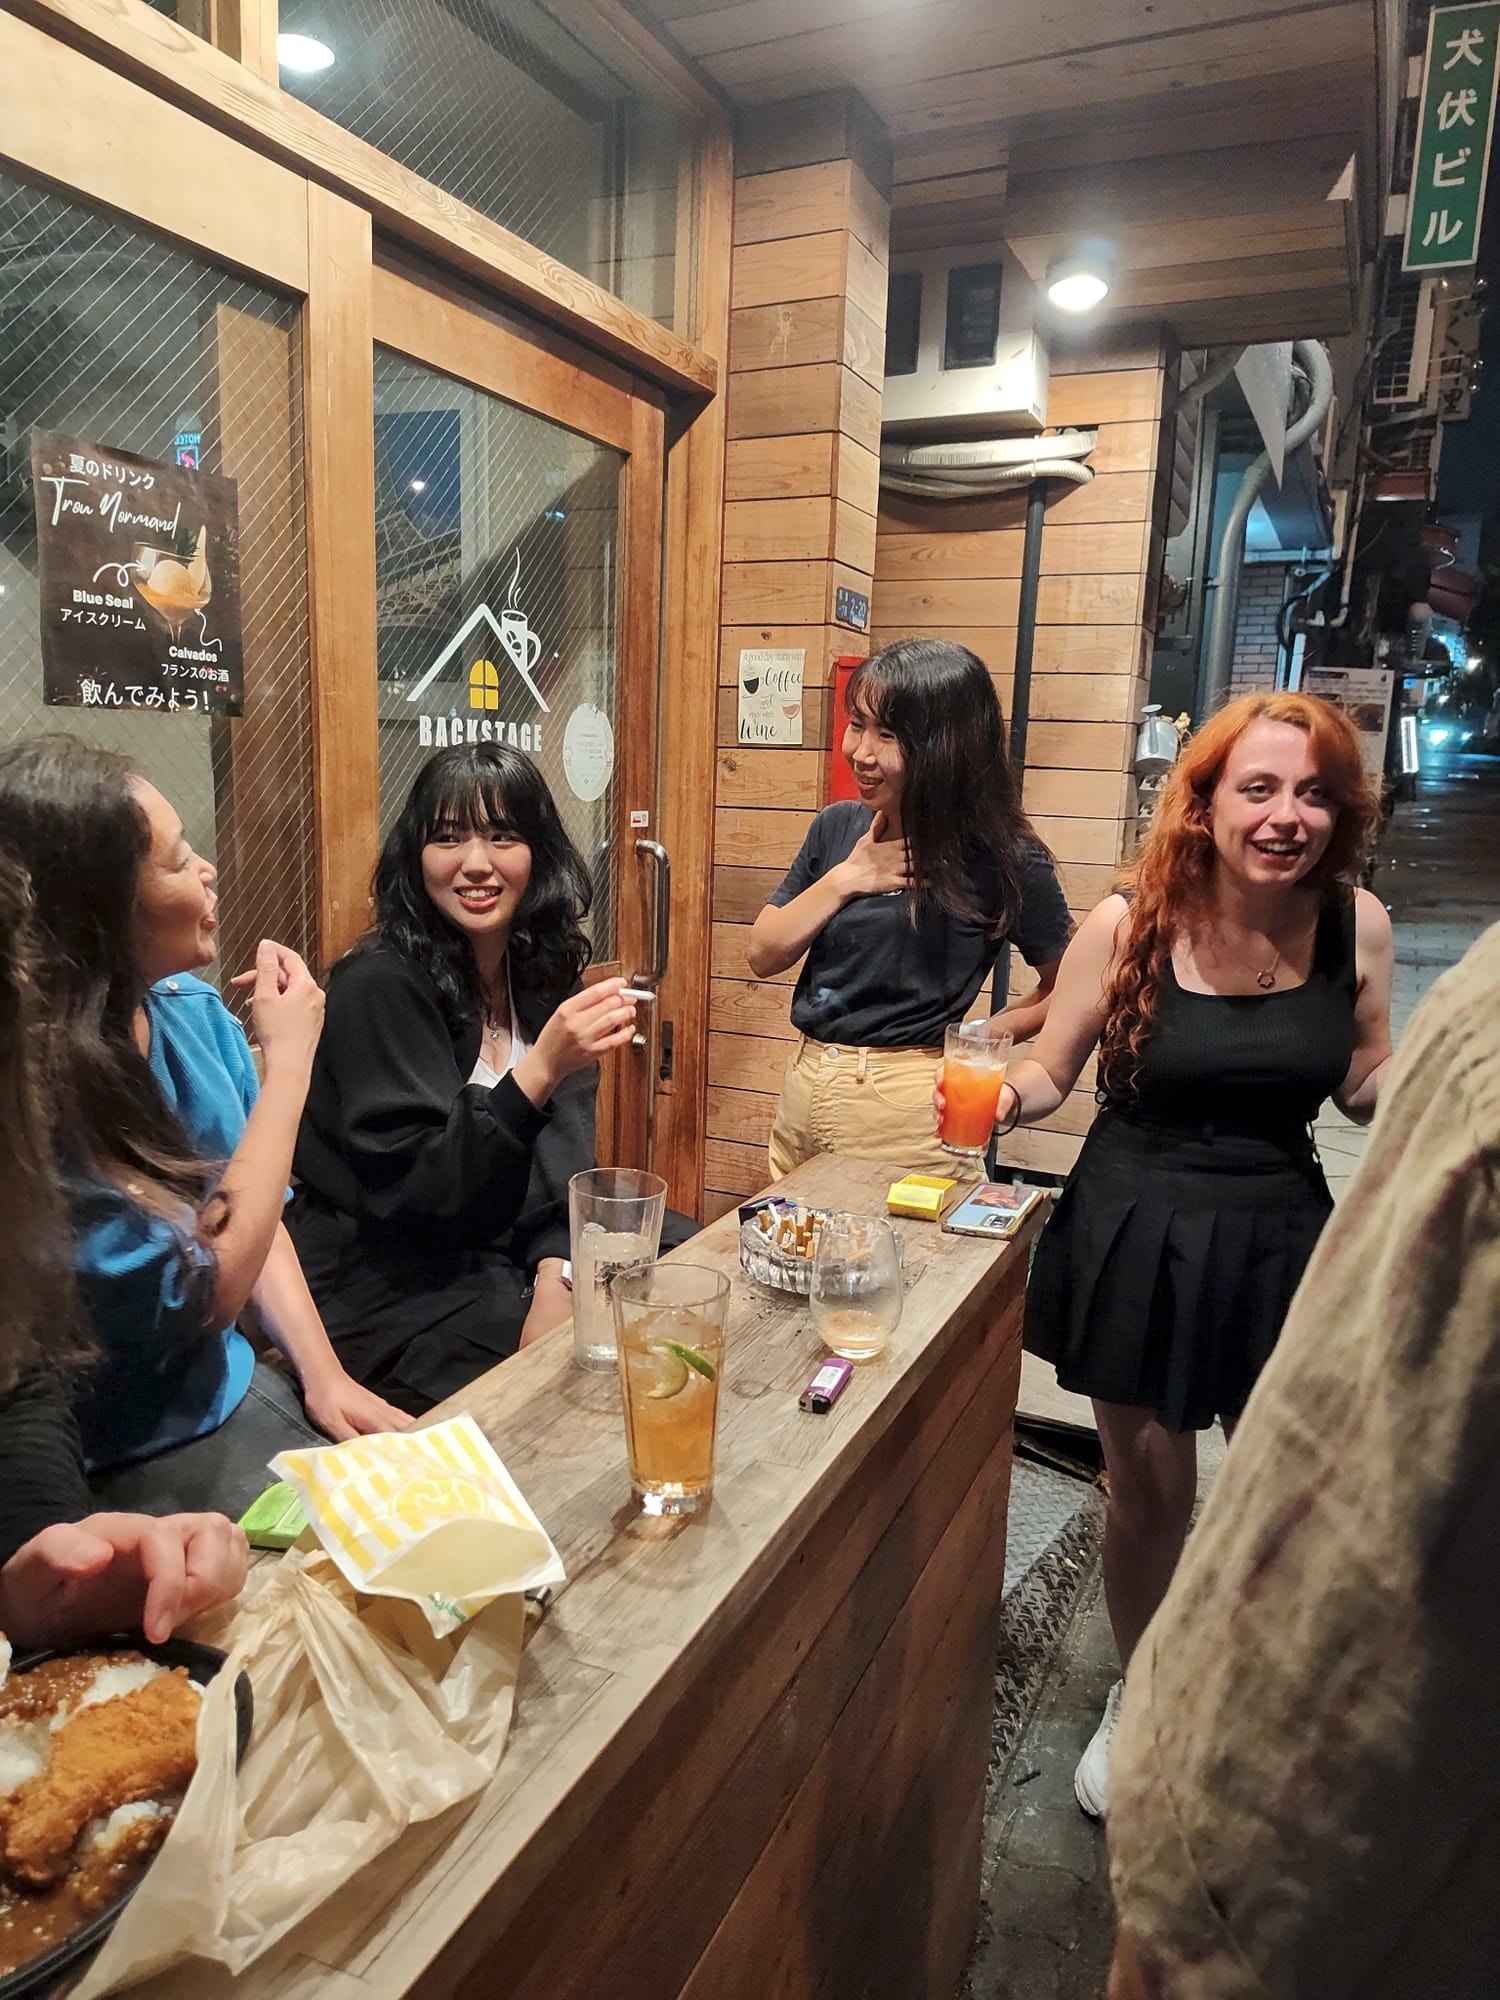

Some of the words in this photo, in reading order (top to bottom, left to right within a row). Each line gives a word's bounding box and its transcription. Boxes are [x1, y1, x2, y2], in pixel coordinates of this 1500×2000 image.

[1422, 28, 1485, 247] 犬伏ビル
[68, 453, 155, 490] 夏のドリンク
[100, 490, 182, 540] Normand
[72, 589, 103, 605] Blue
[105, 594, 134, 610] Seal
[60, 608, 146, 631] アイスクリーム
[169, 645, 218, 663] Calvados
[160, 663, 230, 682] フランスのお酒
[765, 667, 802, 692] Coffee
[419, 715, 542, 752] BACKSTAGE
[740, 718, 777, 741] Wine
